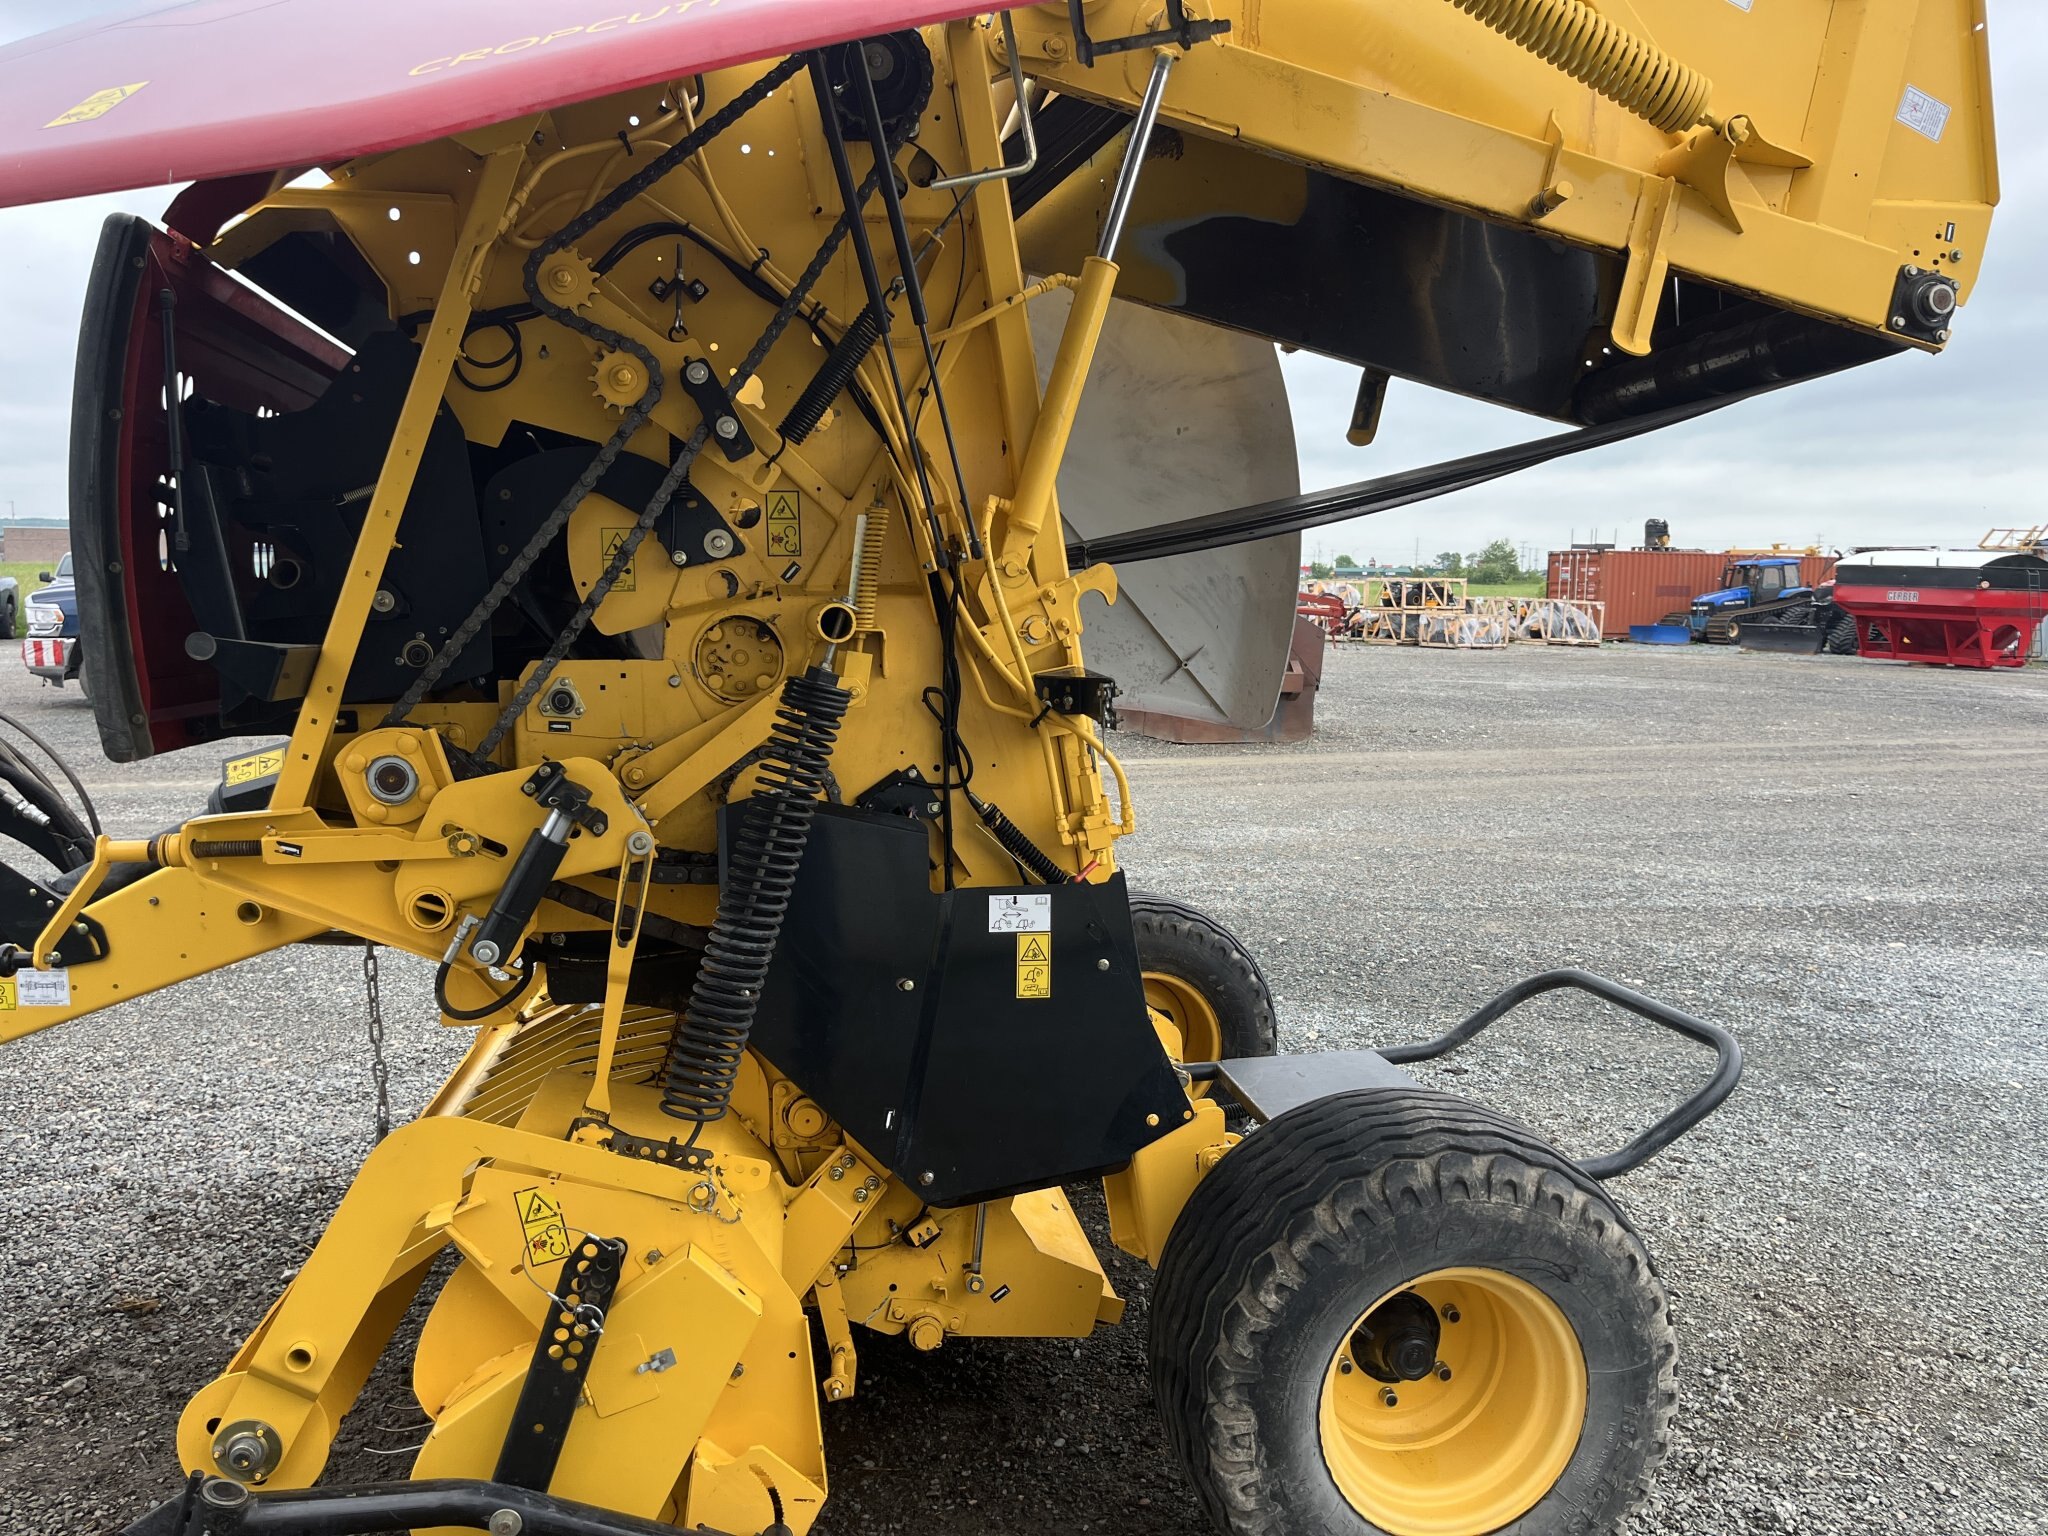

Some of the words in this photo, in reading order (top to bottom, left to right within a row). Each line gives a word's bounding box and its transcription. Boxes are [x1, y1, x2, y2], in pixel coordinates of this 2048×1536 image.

[1887, 591, 1919, 602] GERBER
[1435, 1219, 1628, 1329] CARSLE
[1604, 1421, 1617, 1443] LOW
